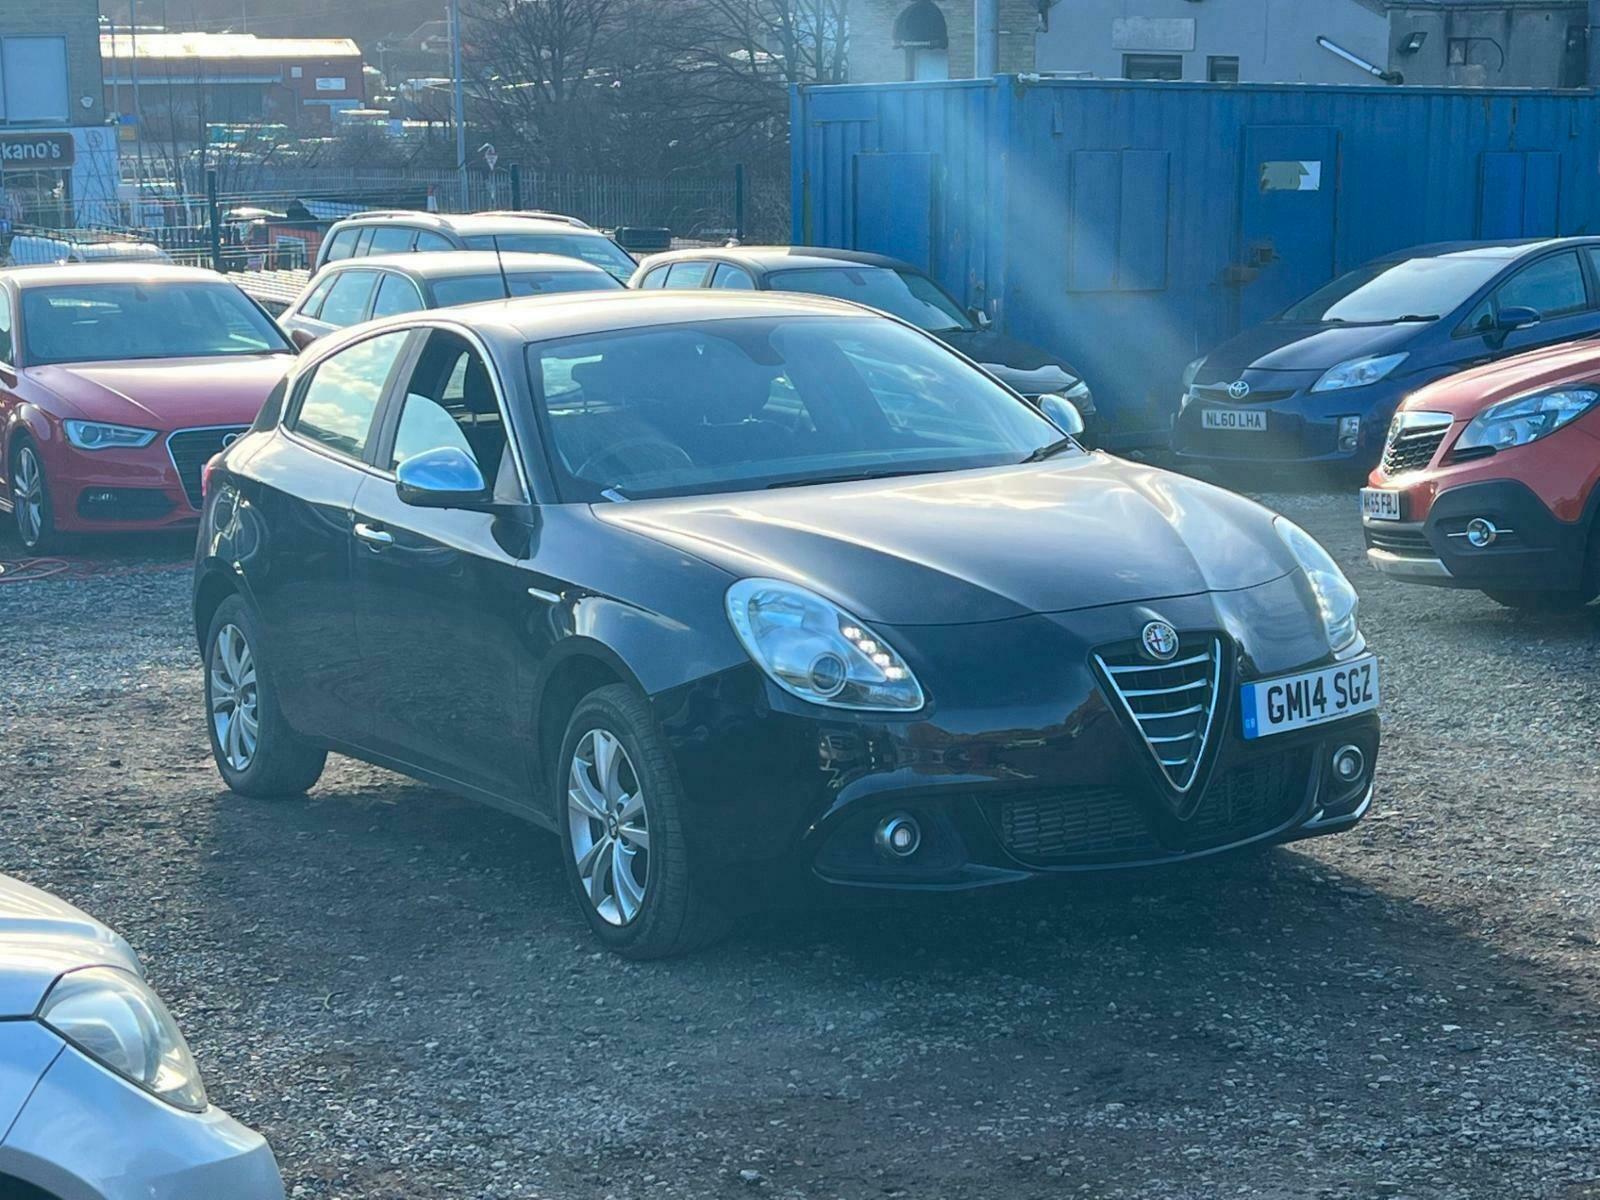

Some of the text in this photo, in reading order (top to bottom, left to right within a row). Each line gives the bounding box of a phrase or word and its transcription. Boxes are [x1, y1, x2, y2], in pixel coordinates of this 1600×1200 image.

[0, 140, 61, 160] kano's
[1206, 412, 1262, 429] NL60 LHA
[1267, 663, 1373, 724] GM14 SGZ
